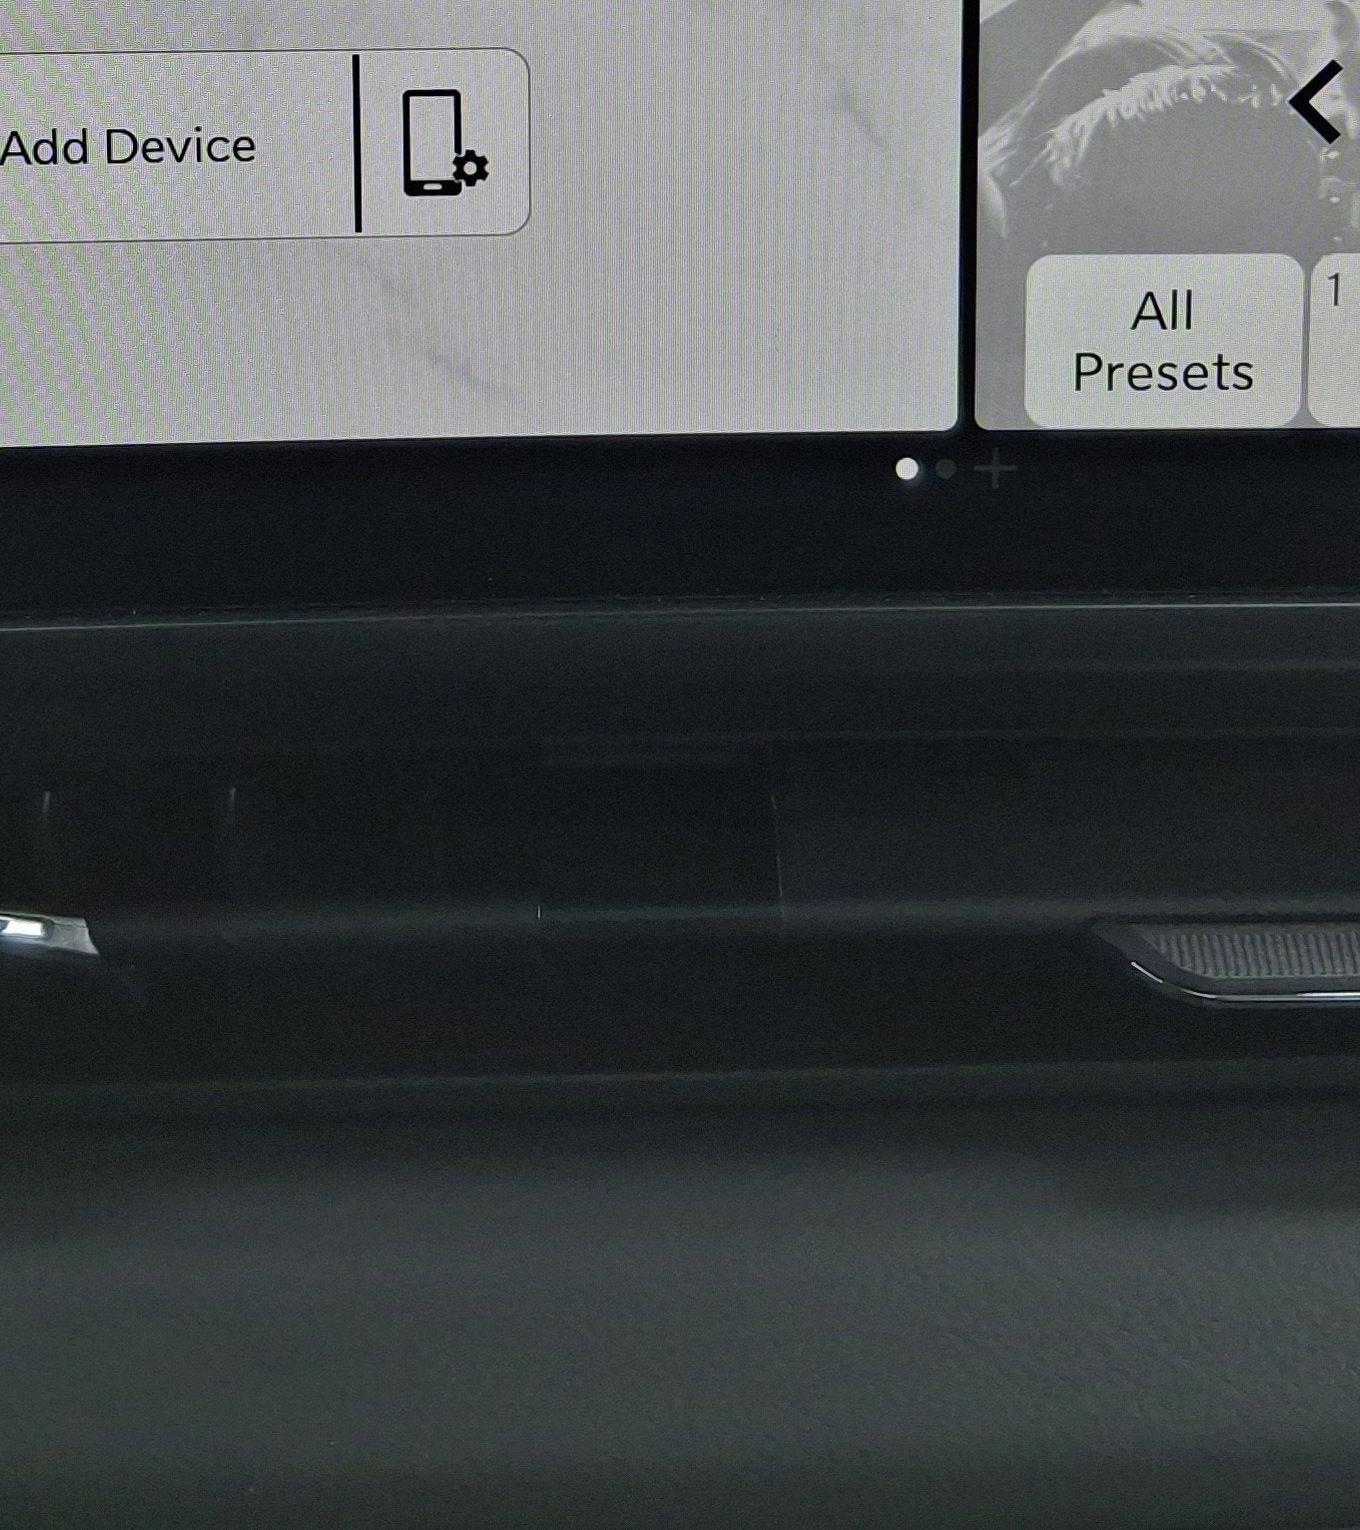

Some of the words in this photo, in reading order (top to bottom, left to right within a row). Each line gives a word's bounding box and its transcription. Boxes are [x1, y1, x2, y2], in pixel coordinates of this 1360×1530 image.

[105, 124, 257, 167] Device
[1129, 288, 1194, 332] All
[1326, 272, 1341, 308] 1
[1073, 351, 1255, 393] Presets
